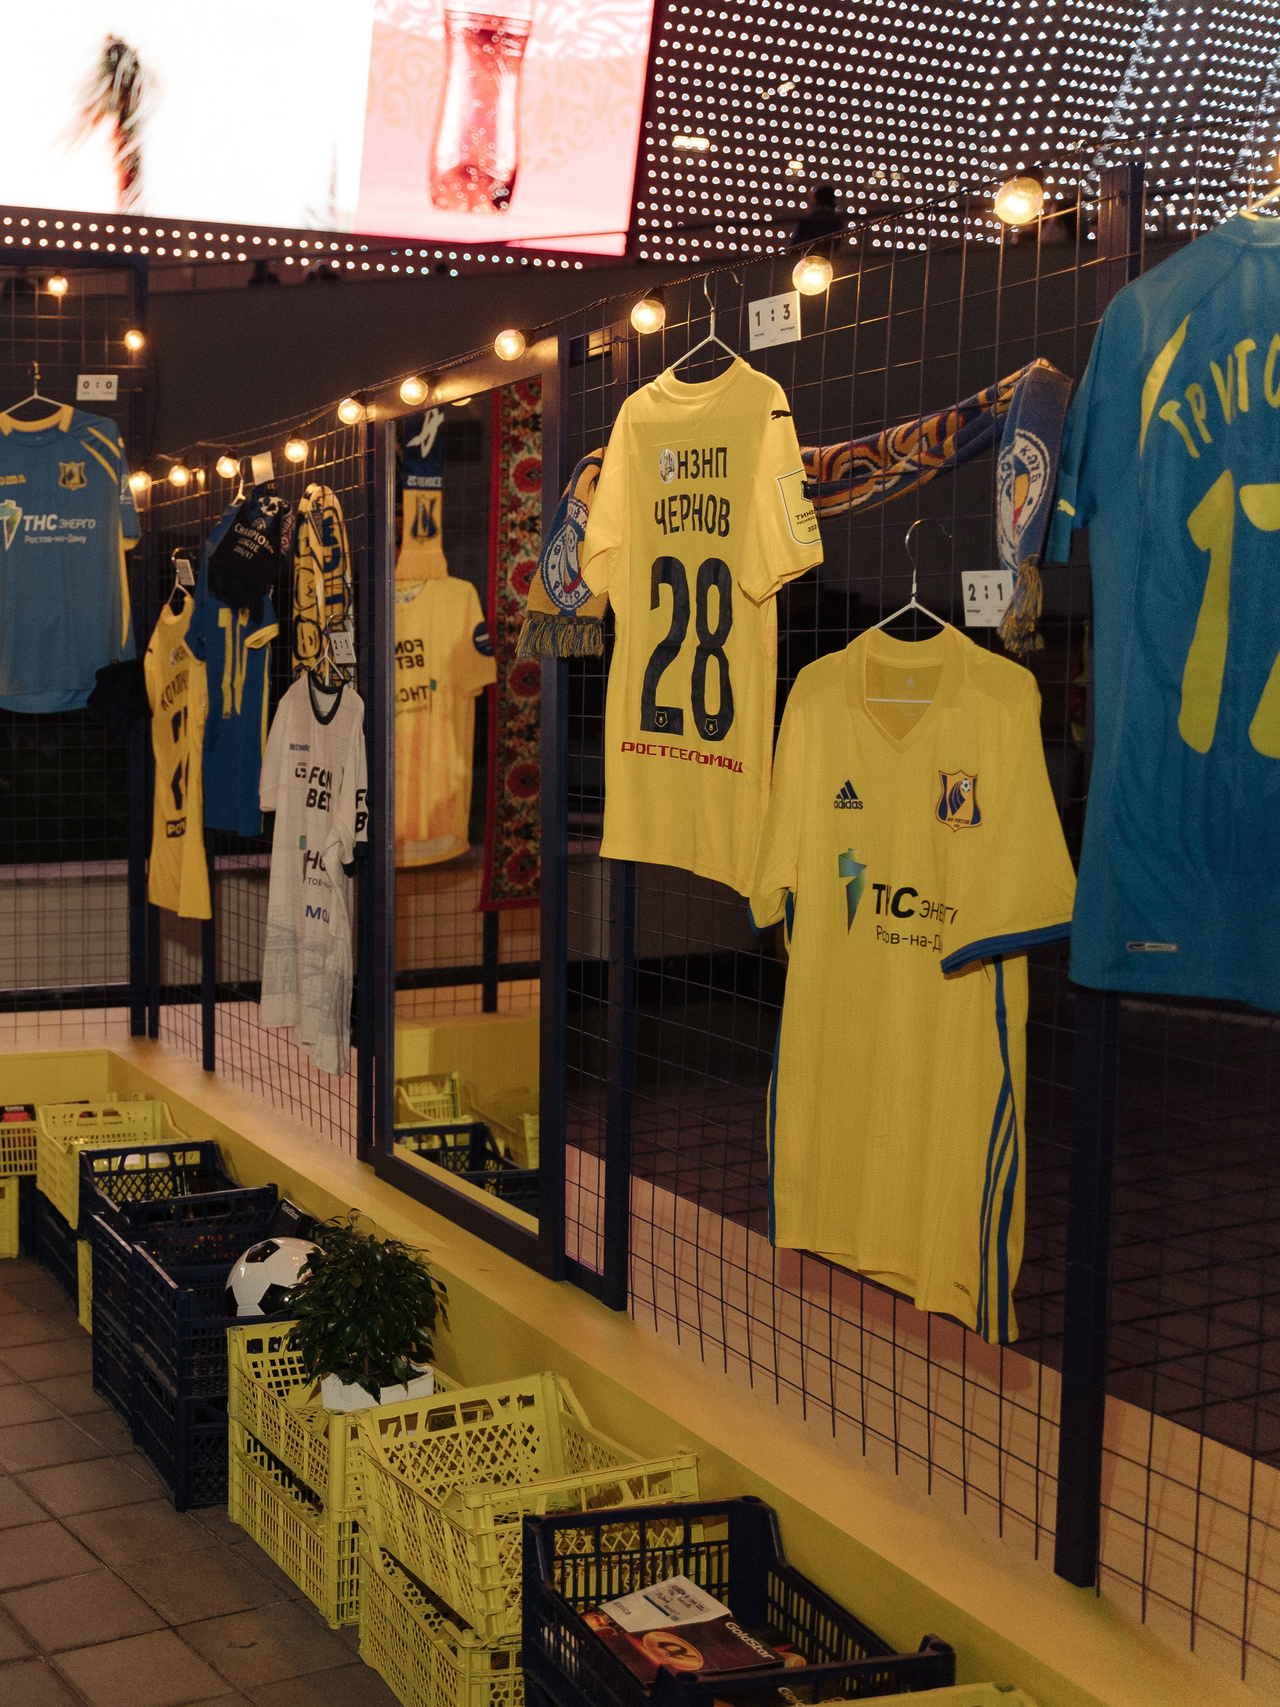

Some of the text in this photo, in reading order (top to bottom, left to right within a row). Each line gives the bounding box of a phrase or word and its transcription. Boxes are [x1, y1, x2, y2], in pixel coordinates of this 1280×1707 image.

[677, 447, 728, 479] НЗНП
[23, 513, 59, 532] ТНС
[654, 493, 731, 538] ЧЕРНОВ
[640, 555, 735, 742] 28
[833, 800, 864, 810] adidas
[724, 1621, 775, 1661] GoldStar
